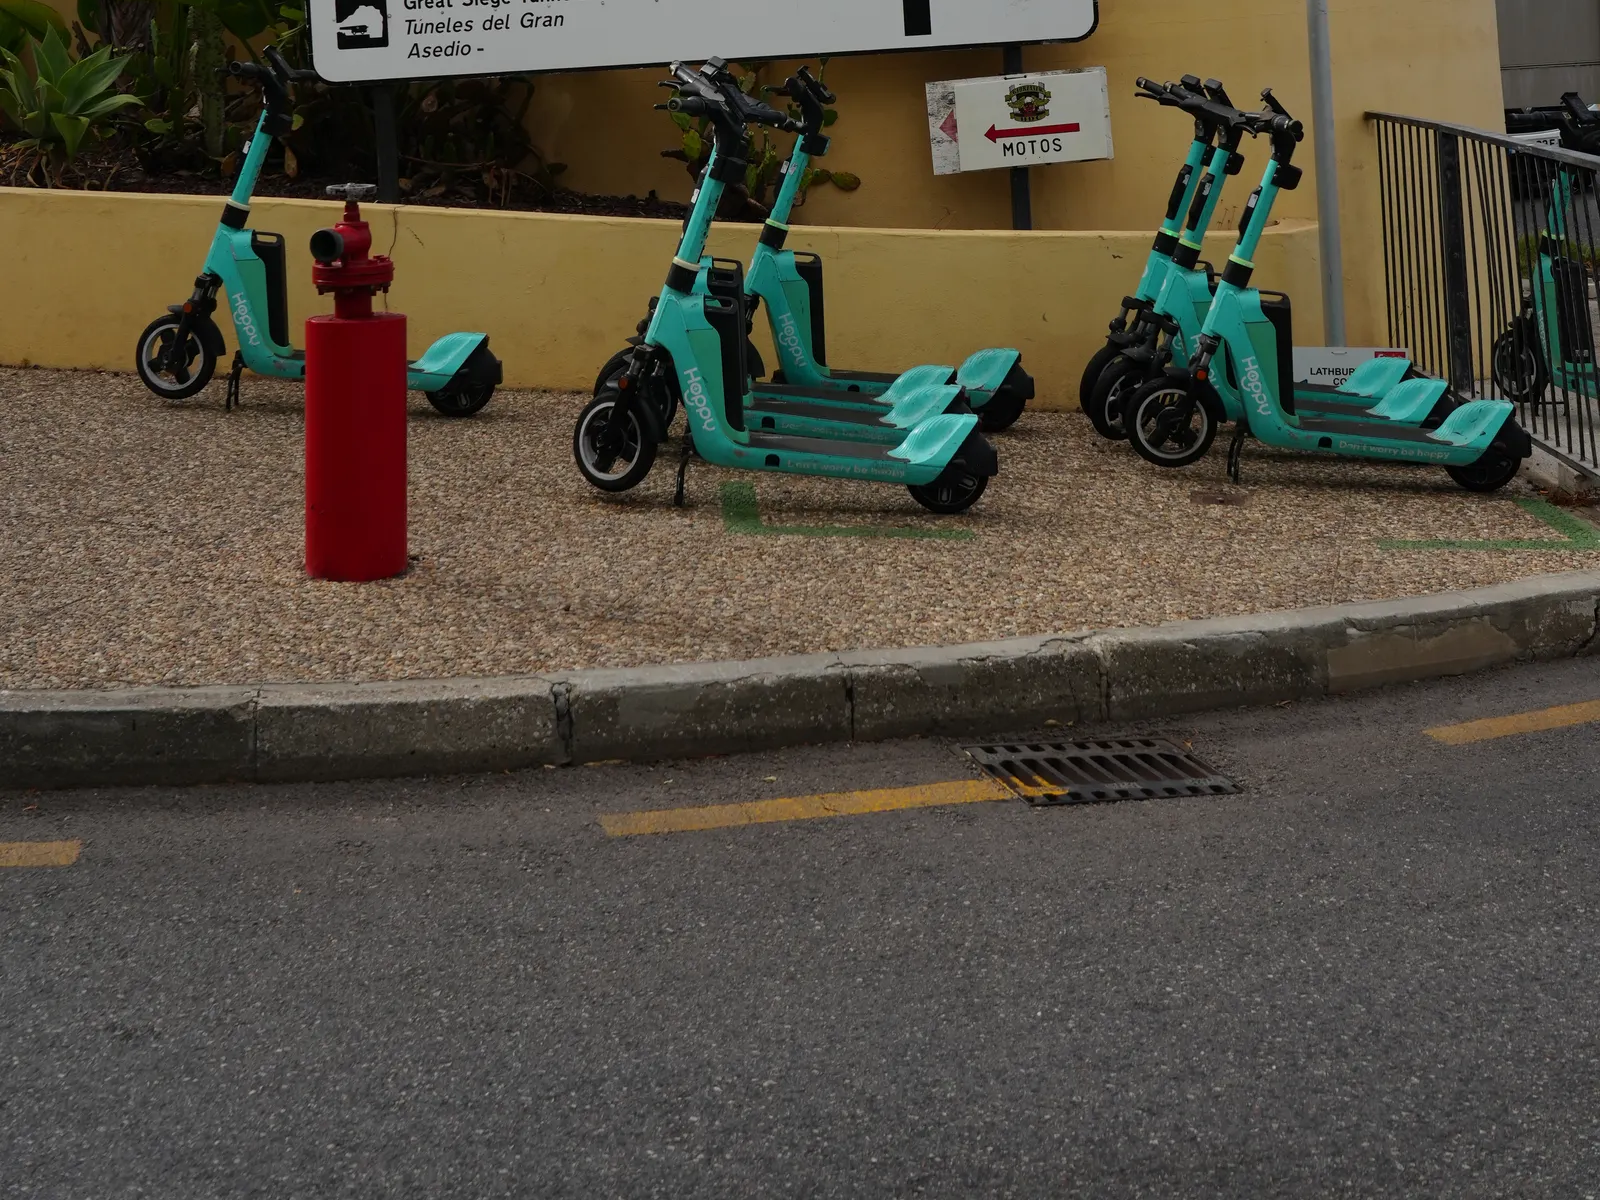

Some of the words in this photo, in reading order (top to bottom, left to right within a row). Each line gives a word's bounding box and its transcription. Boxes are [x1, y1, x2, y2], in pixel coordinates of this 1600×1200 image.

[405, 17, 473, 36] Túneles
[482, 14, 511, 31] del
[519, 12, 564, 30] Gran
[407, 41, 471, 59] Asedio
[1003, 138, 1062, 157] MOTOS
[232, 292, 261, 346] Hoppy
[778, 312, 807, 367] Hoppy
[1241, 355, 1272, 416] Hoppy
[1310, 367, 1357, 376] LATHBUR
[683, 367, 716, 431] Hoppy
